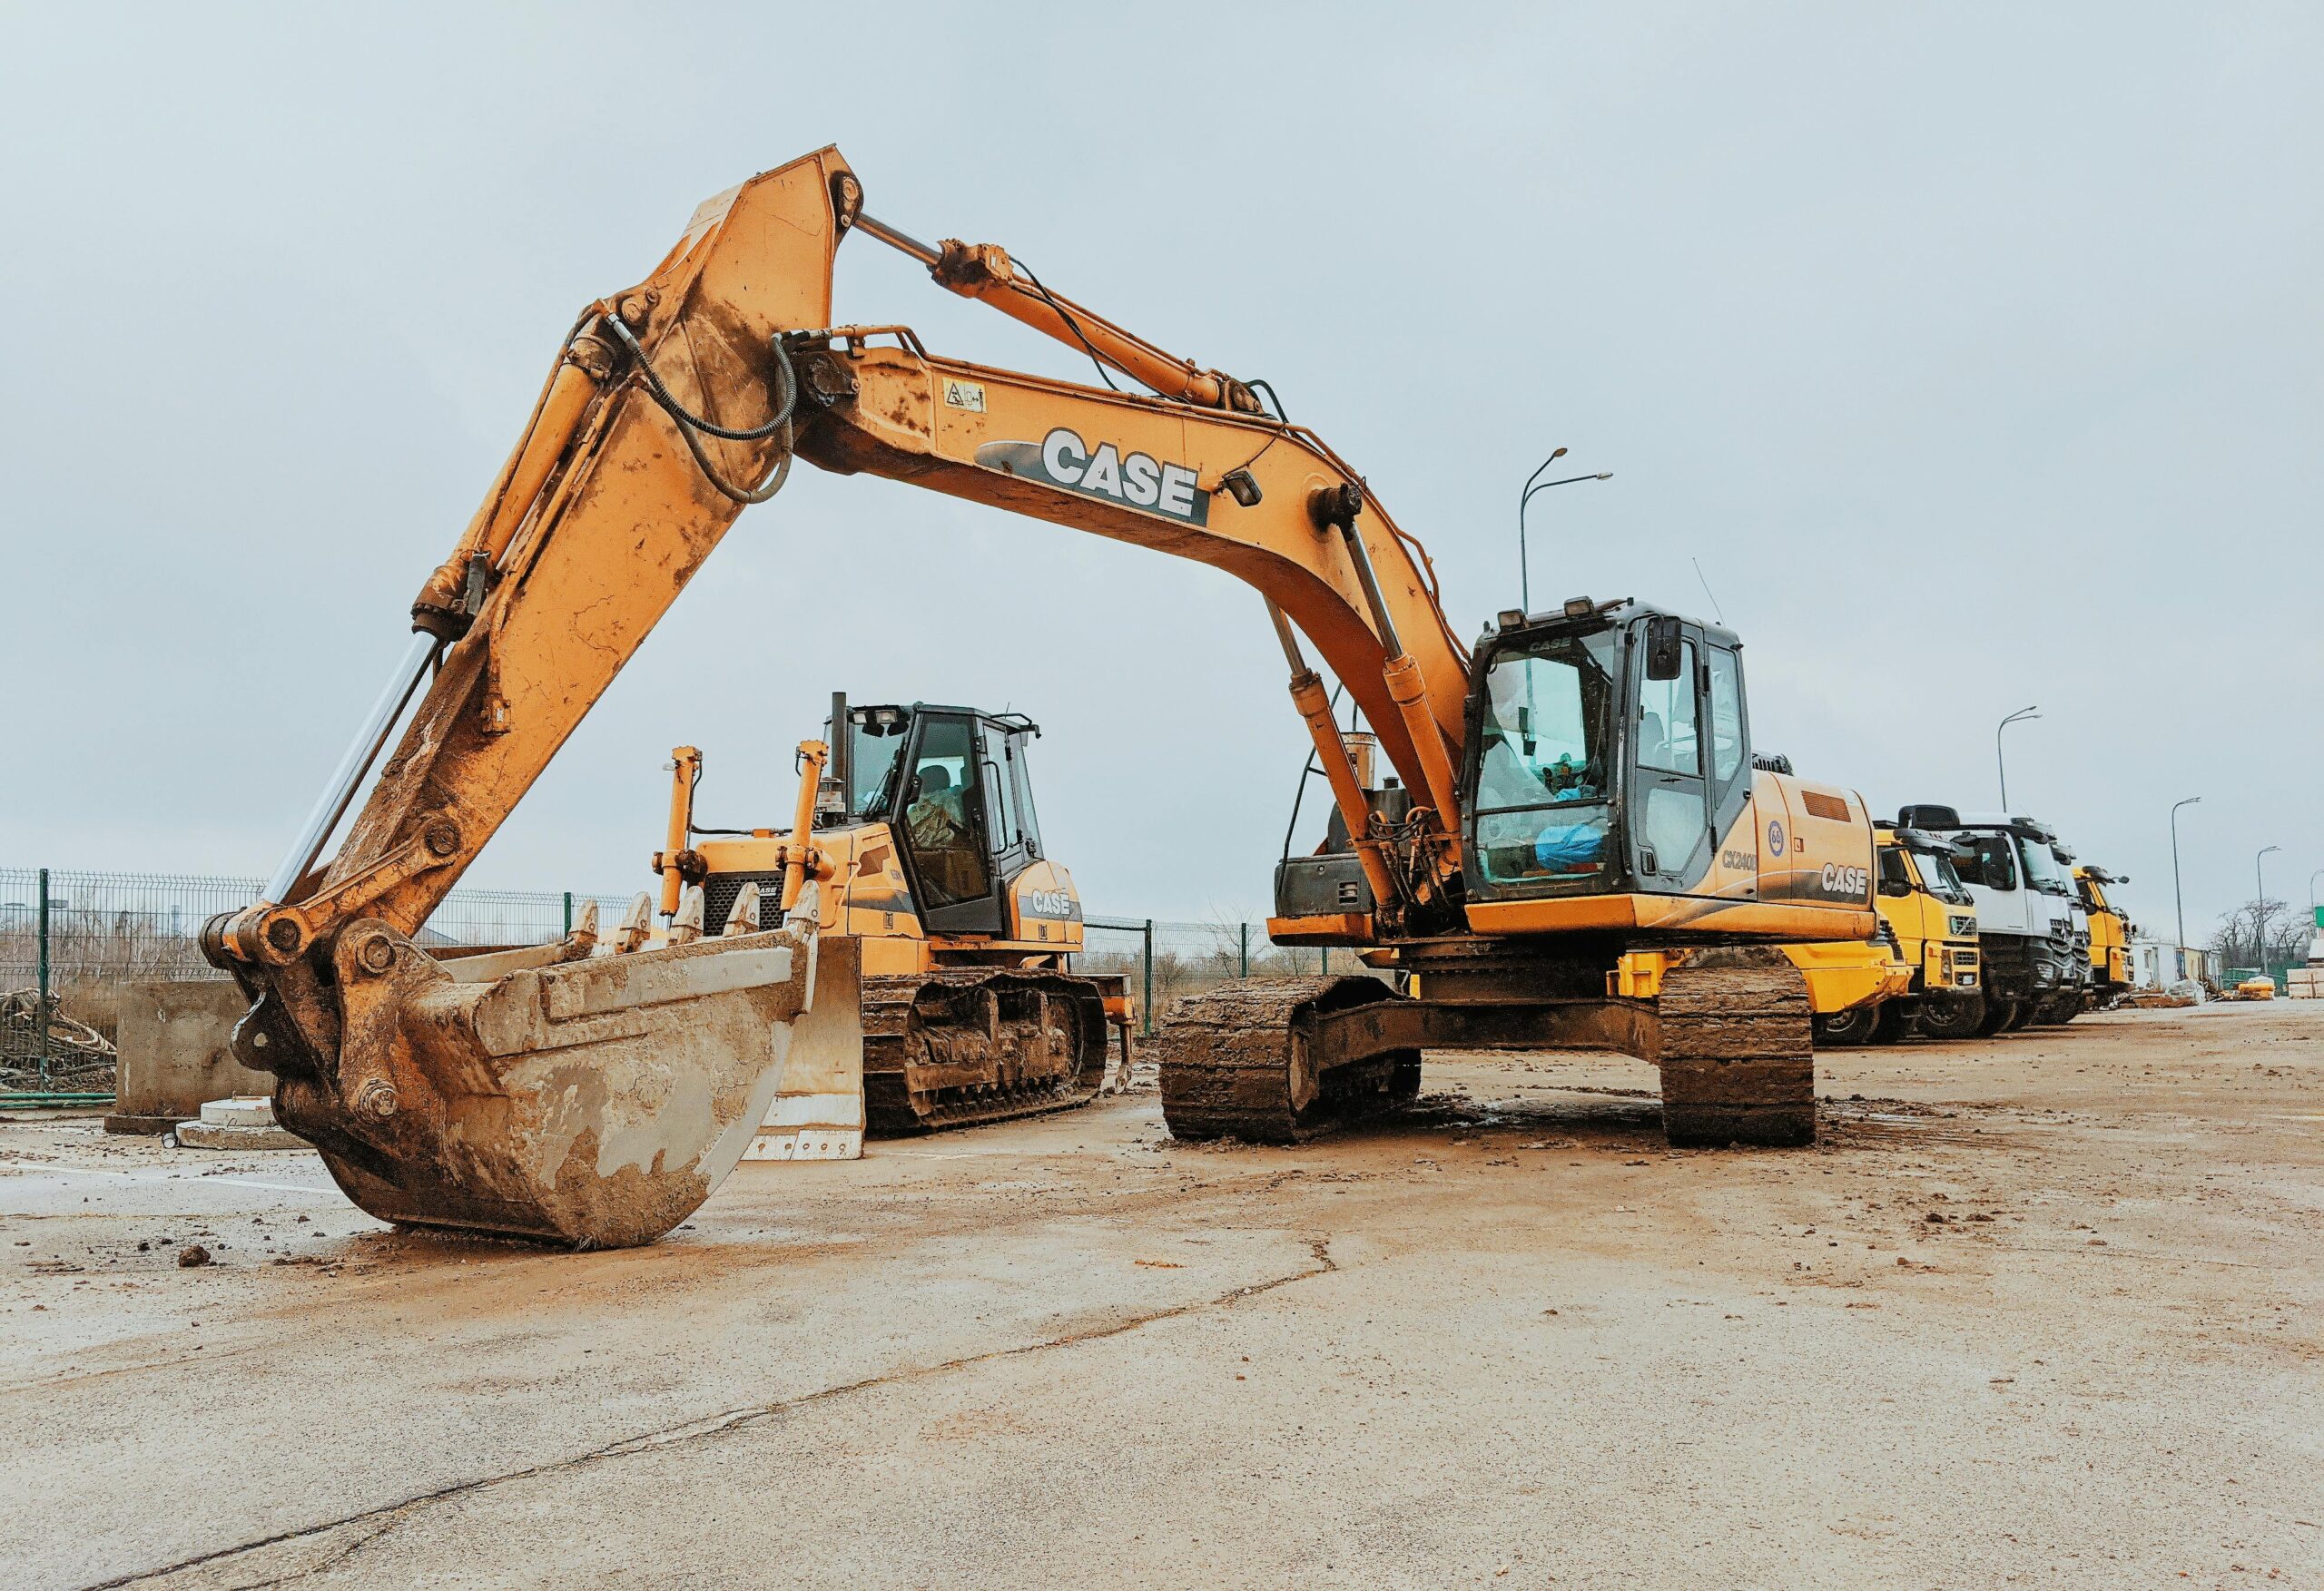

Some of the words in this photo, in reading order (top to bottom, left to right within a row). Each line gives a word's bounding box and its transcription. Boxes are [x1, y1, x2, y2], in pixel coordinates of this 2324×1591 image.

[1043, 429, 1198, 517] CASE
[1530, 637, 1571, 652] CASE
[759, 886, 778, 894] ASE
[1822, 862, 1867, 896] CASE
[1032, 889, 1070, 915] CASE
